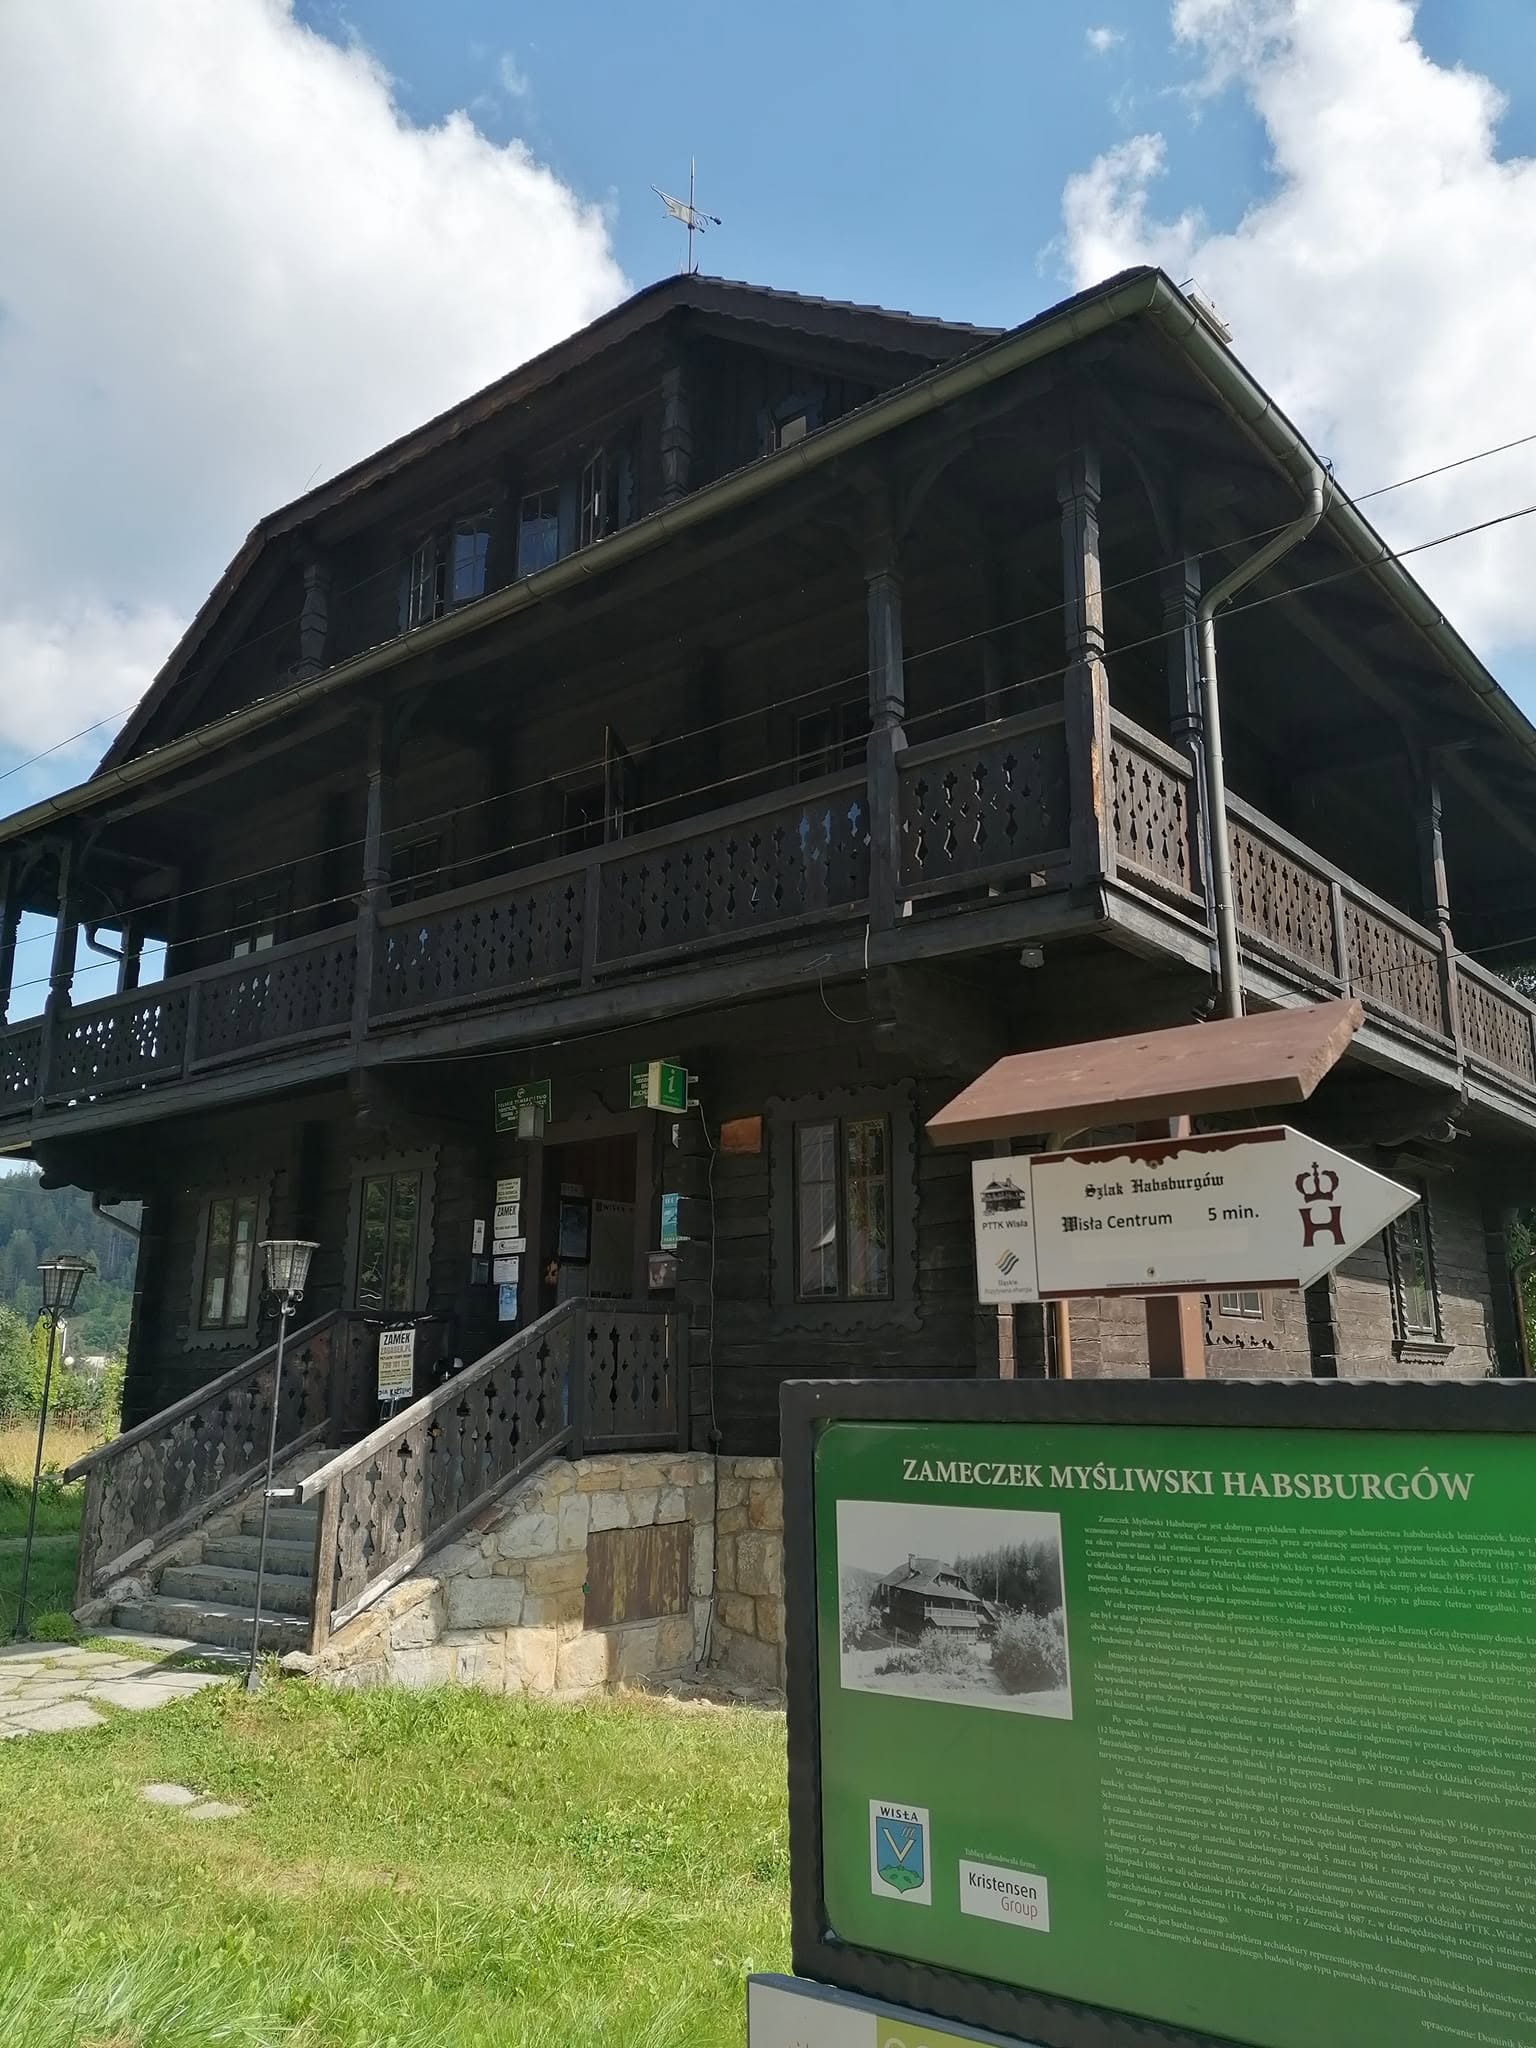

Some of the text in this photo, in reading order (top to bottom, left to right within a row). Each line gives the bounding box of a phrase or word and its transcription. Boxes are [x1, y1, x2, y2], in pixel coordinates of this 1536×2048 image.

[1084, 1172, 1224, 1200] Szlak Habsburgów
[982, 1220, 1004, 1230] PTTK
[1062, 1204, 1260, 1232] Wisła Centrum 5 min.
[384, 1333, 410, 1345] ZAMEK
[903, 1458, 1474, 1501] ZAMECZEK MYŚLIWSKI HABSBURGÓW
[880, 1806, 919, 1822] WISŁA
[969, 1872, 1037, 1900] Kristensen
[1001, 1896, 1038, 1920] Group
